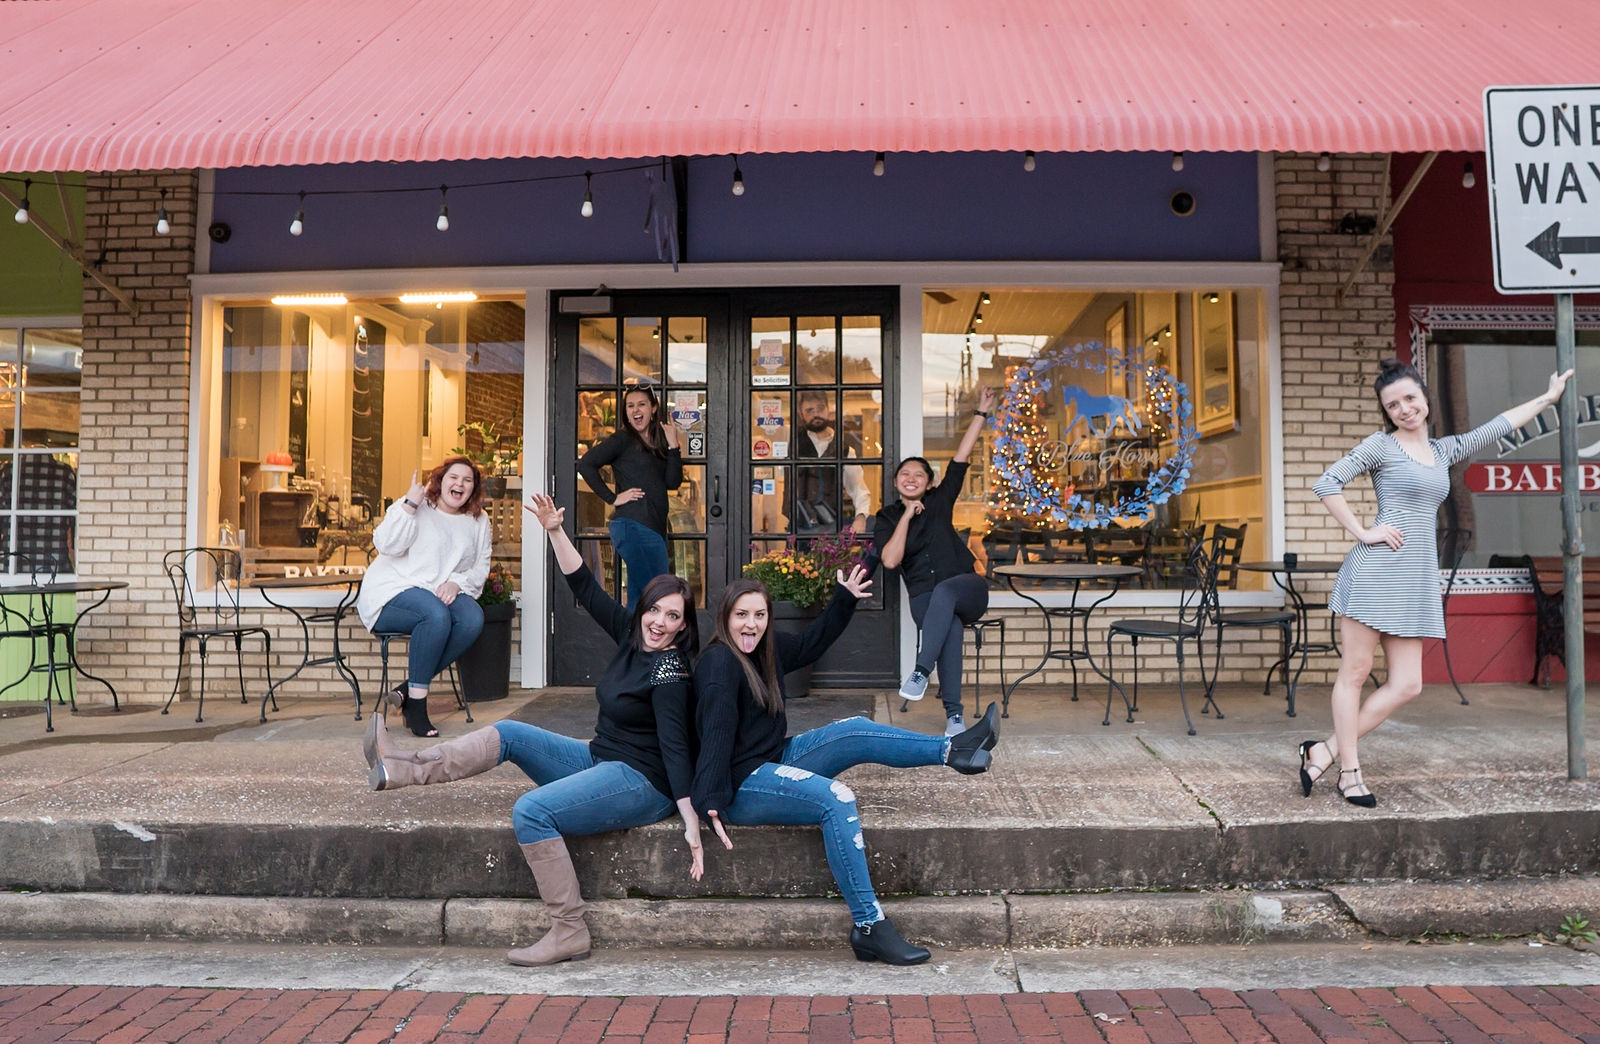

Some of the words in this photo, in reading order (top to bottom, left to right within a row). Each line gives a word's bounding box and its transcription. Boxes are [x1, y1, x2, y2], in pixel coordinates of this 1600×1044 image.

[1517, 105, 1600, 148] ONE
[1037, 440, 1093, 472] Blue
[1098, 440, 1160, 472] Horse
